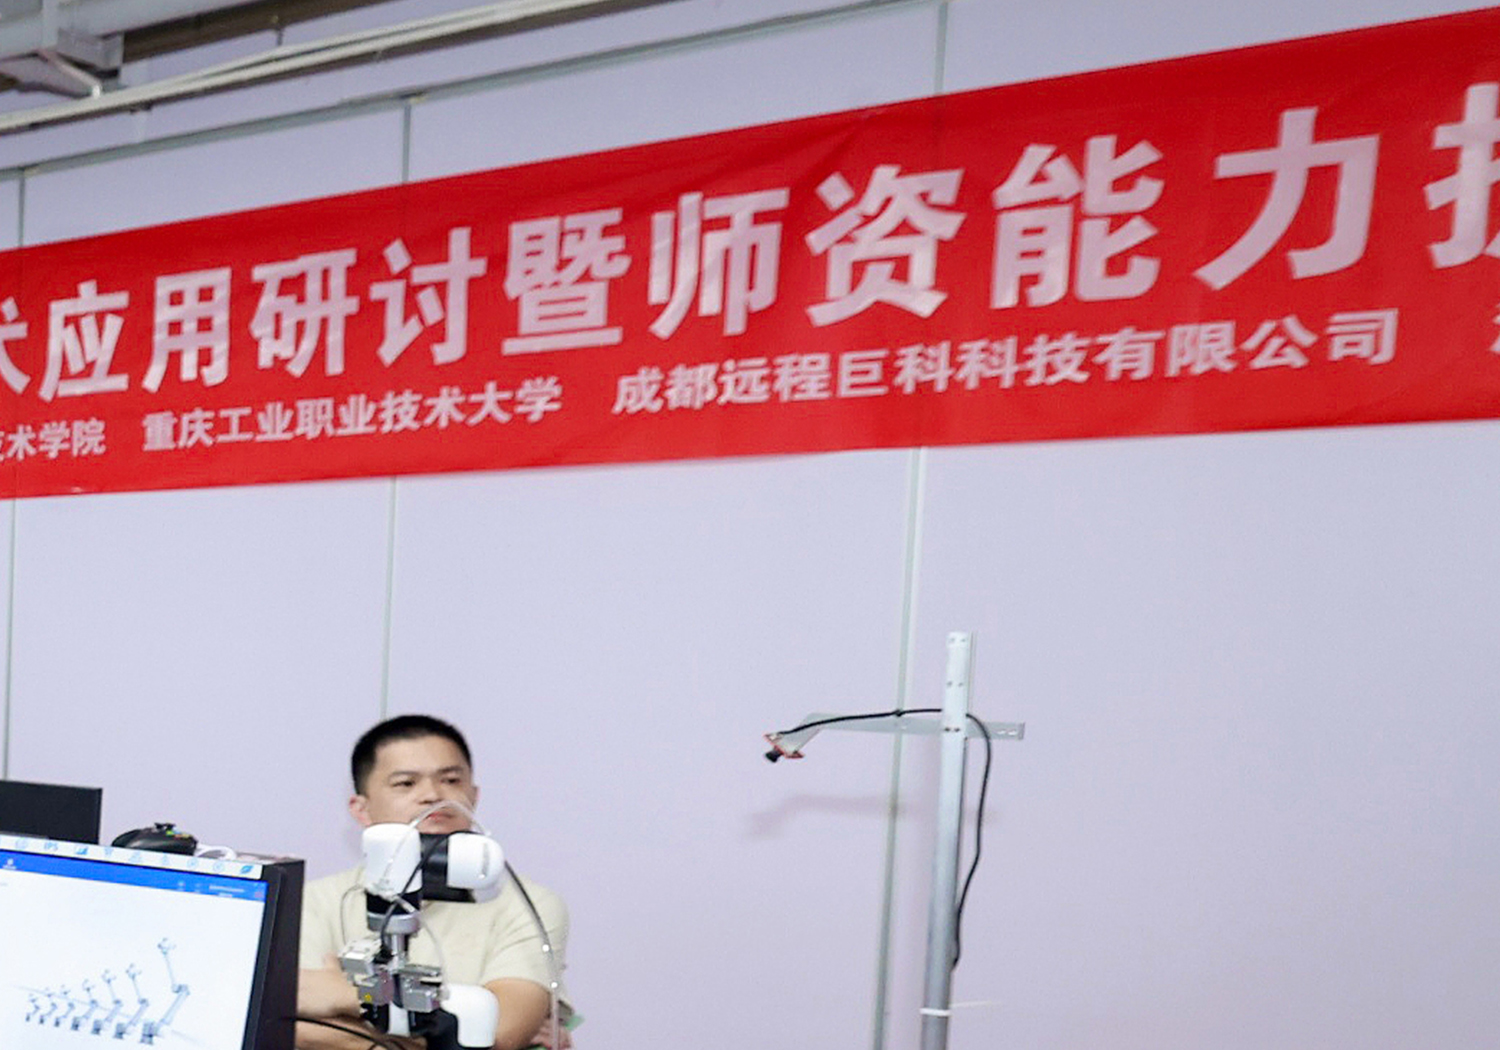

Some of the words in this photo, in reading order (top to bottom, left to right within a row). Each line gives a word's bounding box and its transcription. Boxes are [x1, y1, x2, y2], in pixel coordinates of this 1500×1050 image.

[141, 375, 564, 452] 重庆工业职业技术大学
[610, 307, 1400, 415] 成都远程巨科科技有限公司
